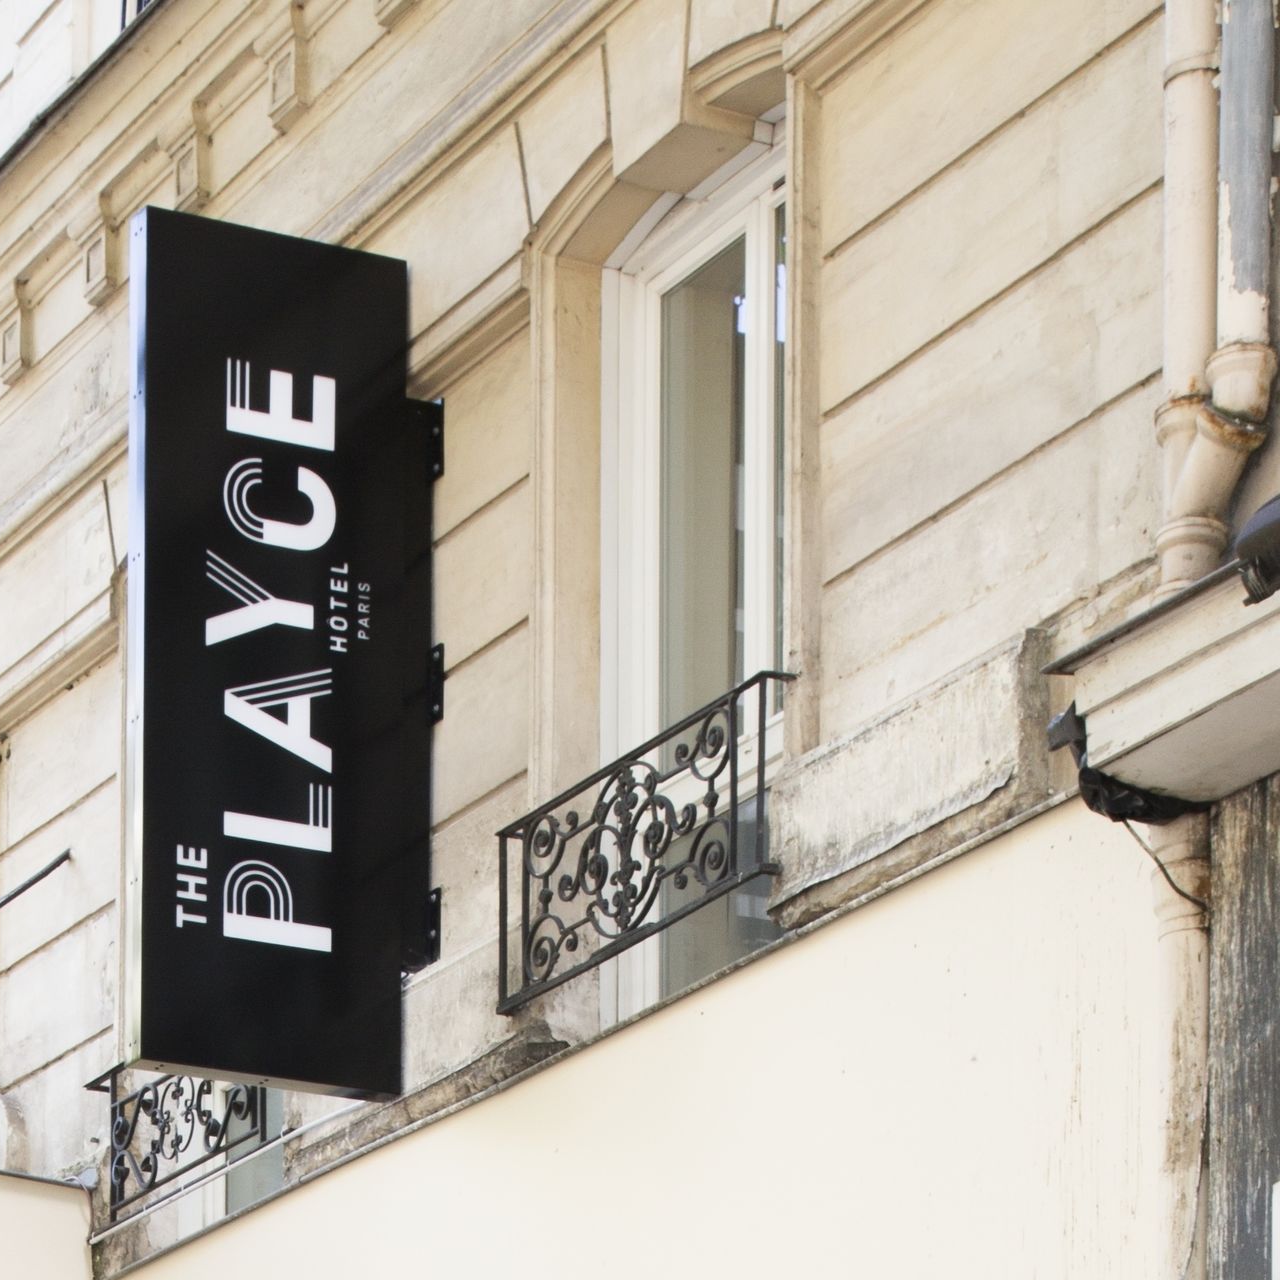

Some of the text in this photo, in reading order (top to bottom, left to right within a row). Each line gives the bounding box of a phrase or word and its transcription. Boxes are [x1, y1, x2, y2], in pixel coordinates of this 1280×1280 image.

[326, 561, 349, 652] HÔTEL
[357, 581, 371, 641] PARIS
[205, 356, 337, 953] PLAYCE
[176, 844, 208, 928] THE
